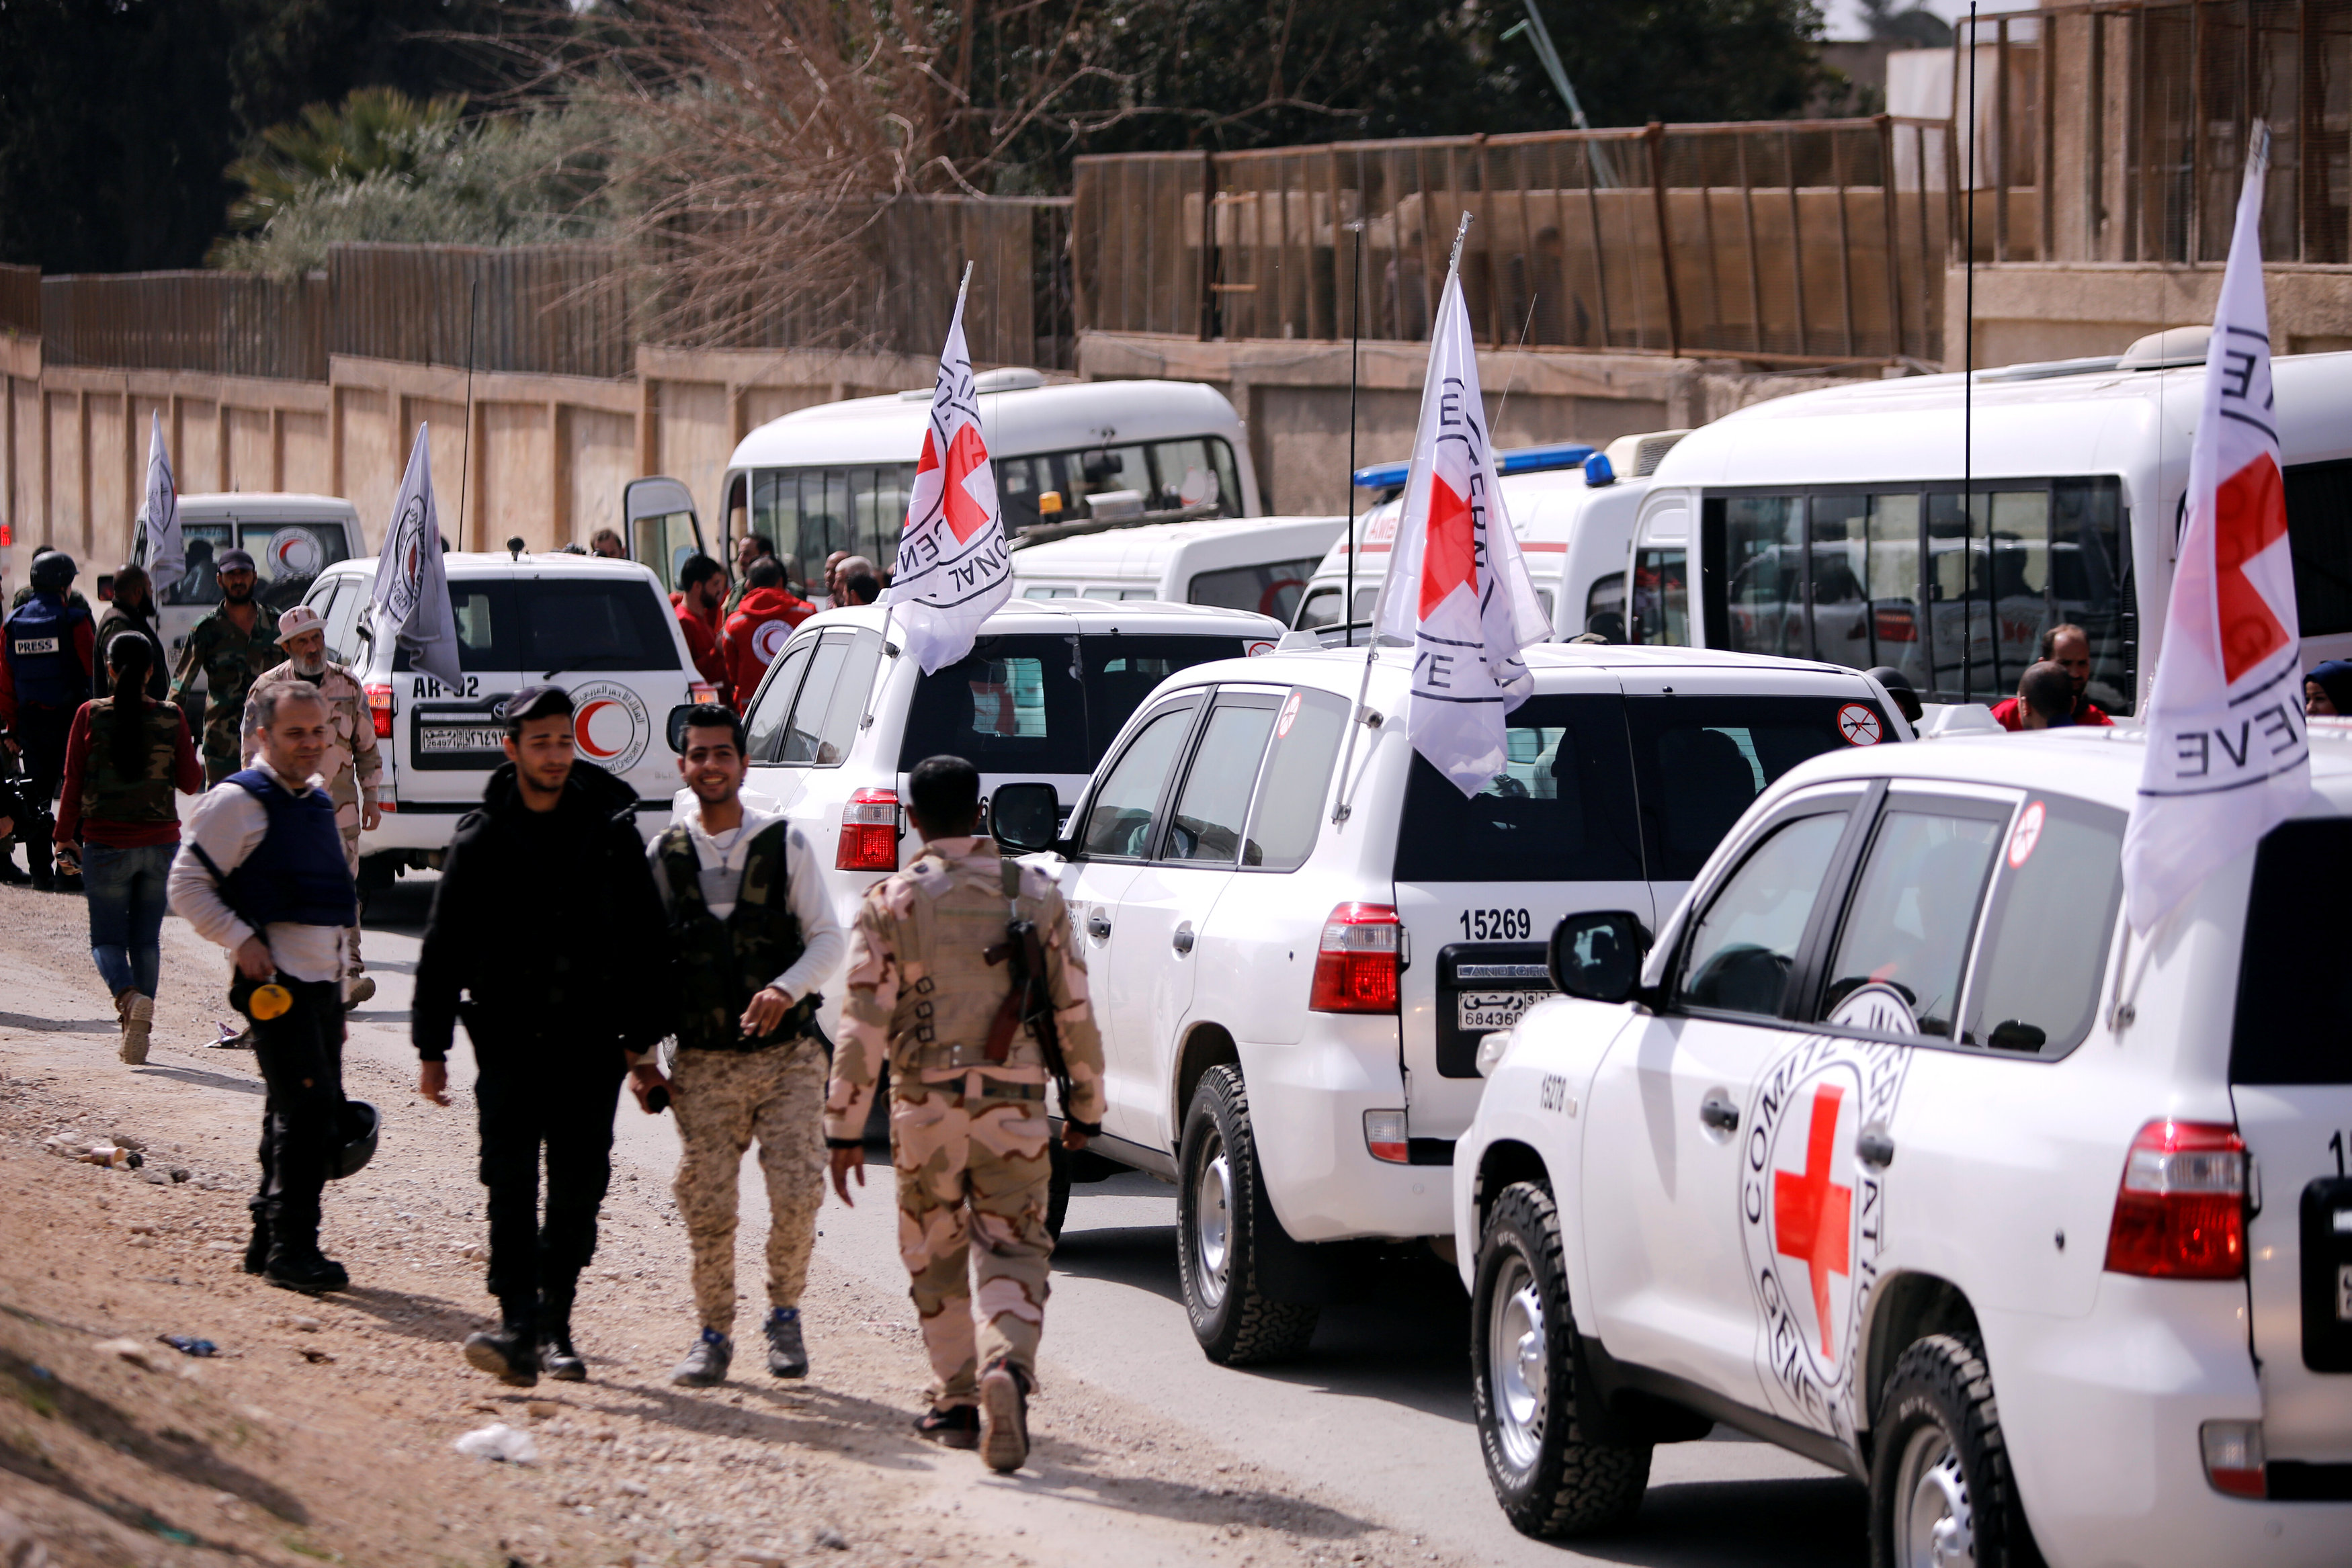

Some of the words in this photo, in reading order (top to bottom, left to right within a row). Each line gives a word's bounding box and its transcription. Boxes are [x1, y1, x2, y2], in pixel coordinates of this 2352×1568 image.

[17, 639, 53, 652] PRESS
[1460, 908, 1531, 940] 15269
[1459, 965, 1509, 976] LAND
[2328, 1130, 2352, 1178] 1
